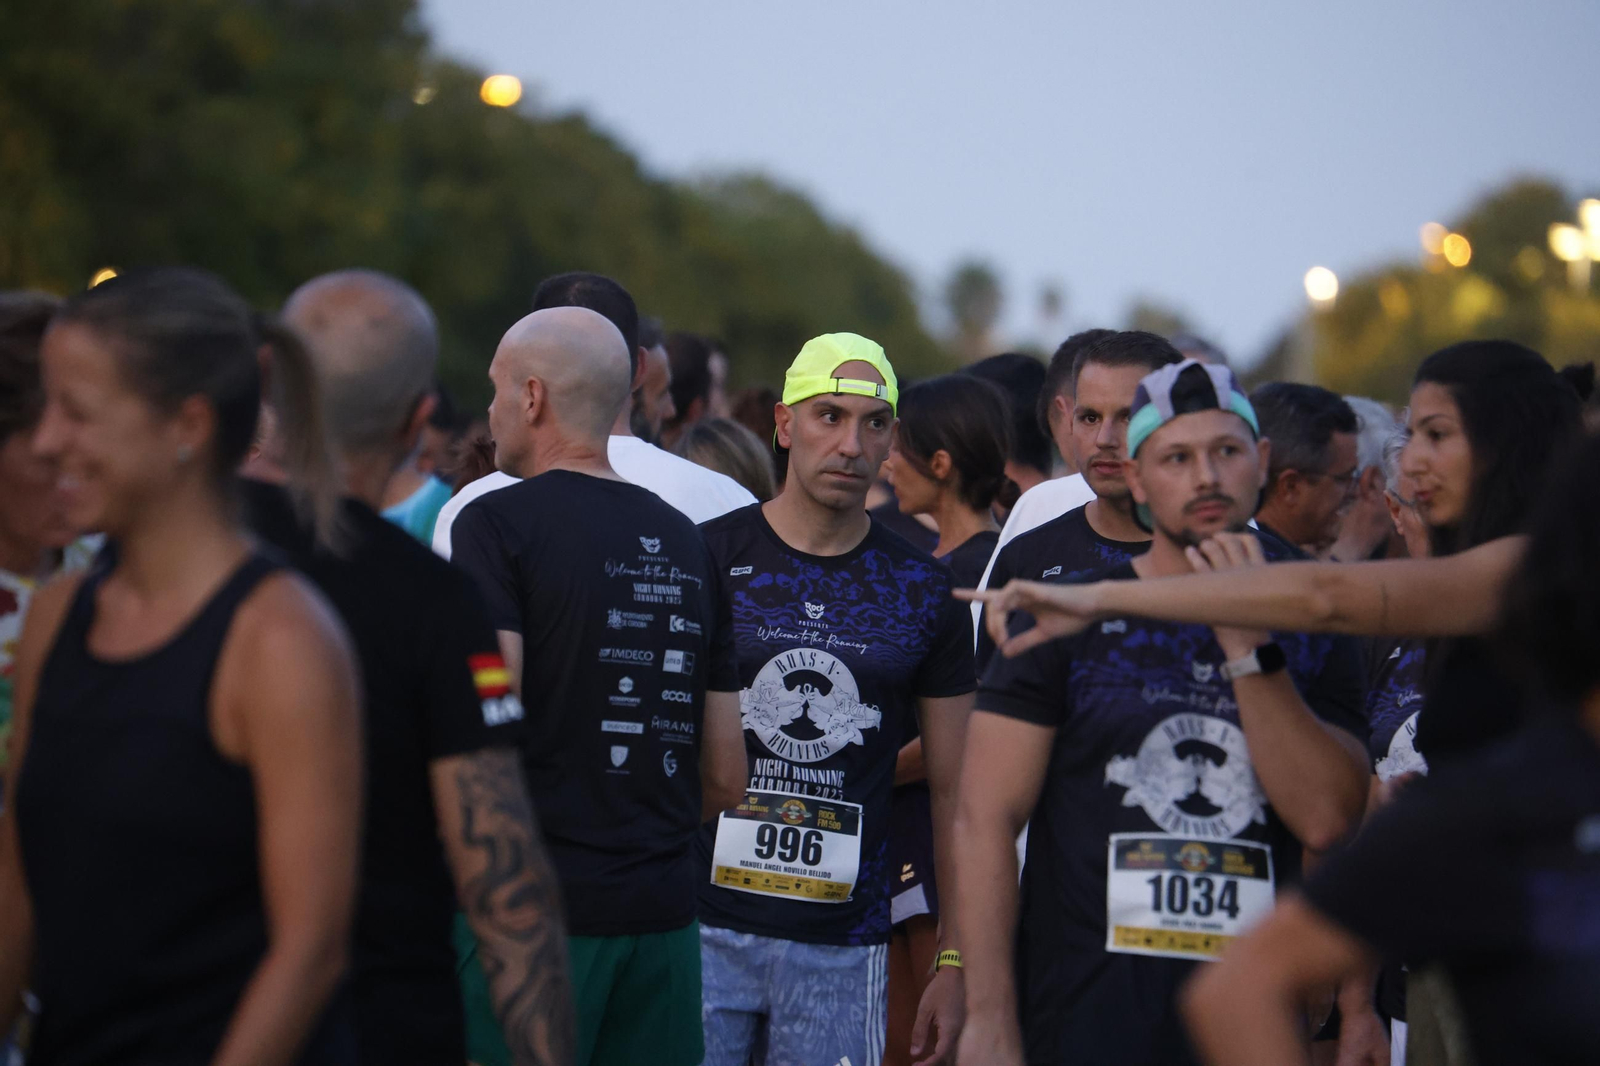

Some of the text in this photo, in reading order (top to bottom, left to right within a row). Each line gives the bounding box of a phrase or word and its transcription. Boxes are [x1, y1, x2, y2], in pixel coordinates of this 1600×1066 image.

[652, 584, 682, 596] RUNNING
[804, 601, 826, 613] Rock
[757, 625, 801, 641] Welcome
[810, 631, 824, 645] the
[825, 633, 870, 655] Running
[612, 648, 655, 662] IMDECO
[767, 732, 831, 760] RUNNERS
[753, 758, 846, 789] NIGHT RUNNING
[817, 809, 837, 821] ROCK
[828, 820, 842, 830] 500
[754, 823, 824, 867] 996
[739, 859, 763, 870] MANUEL
[783, 866, 808, 876] NOVILLO
[808, 869, 832, 879] BELLIDO
[1147, 875, 1240, 920] 1034
